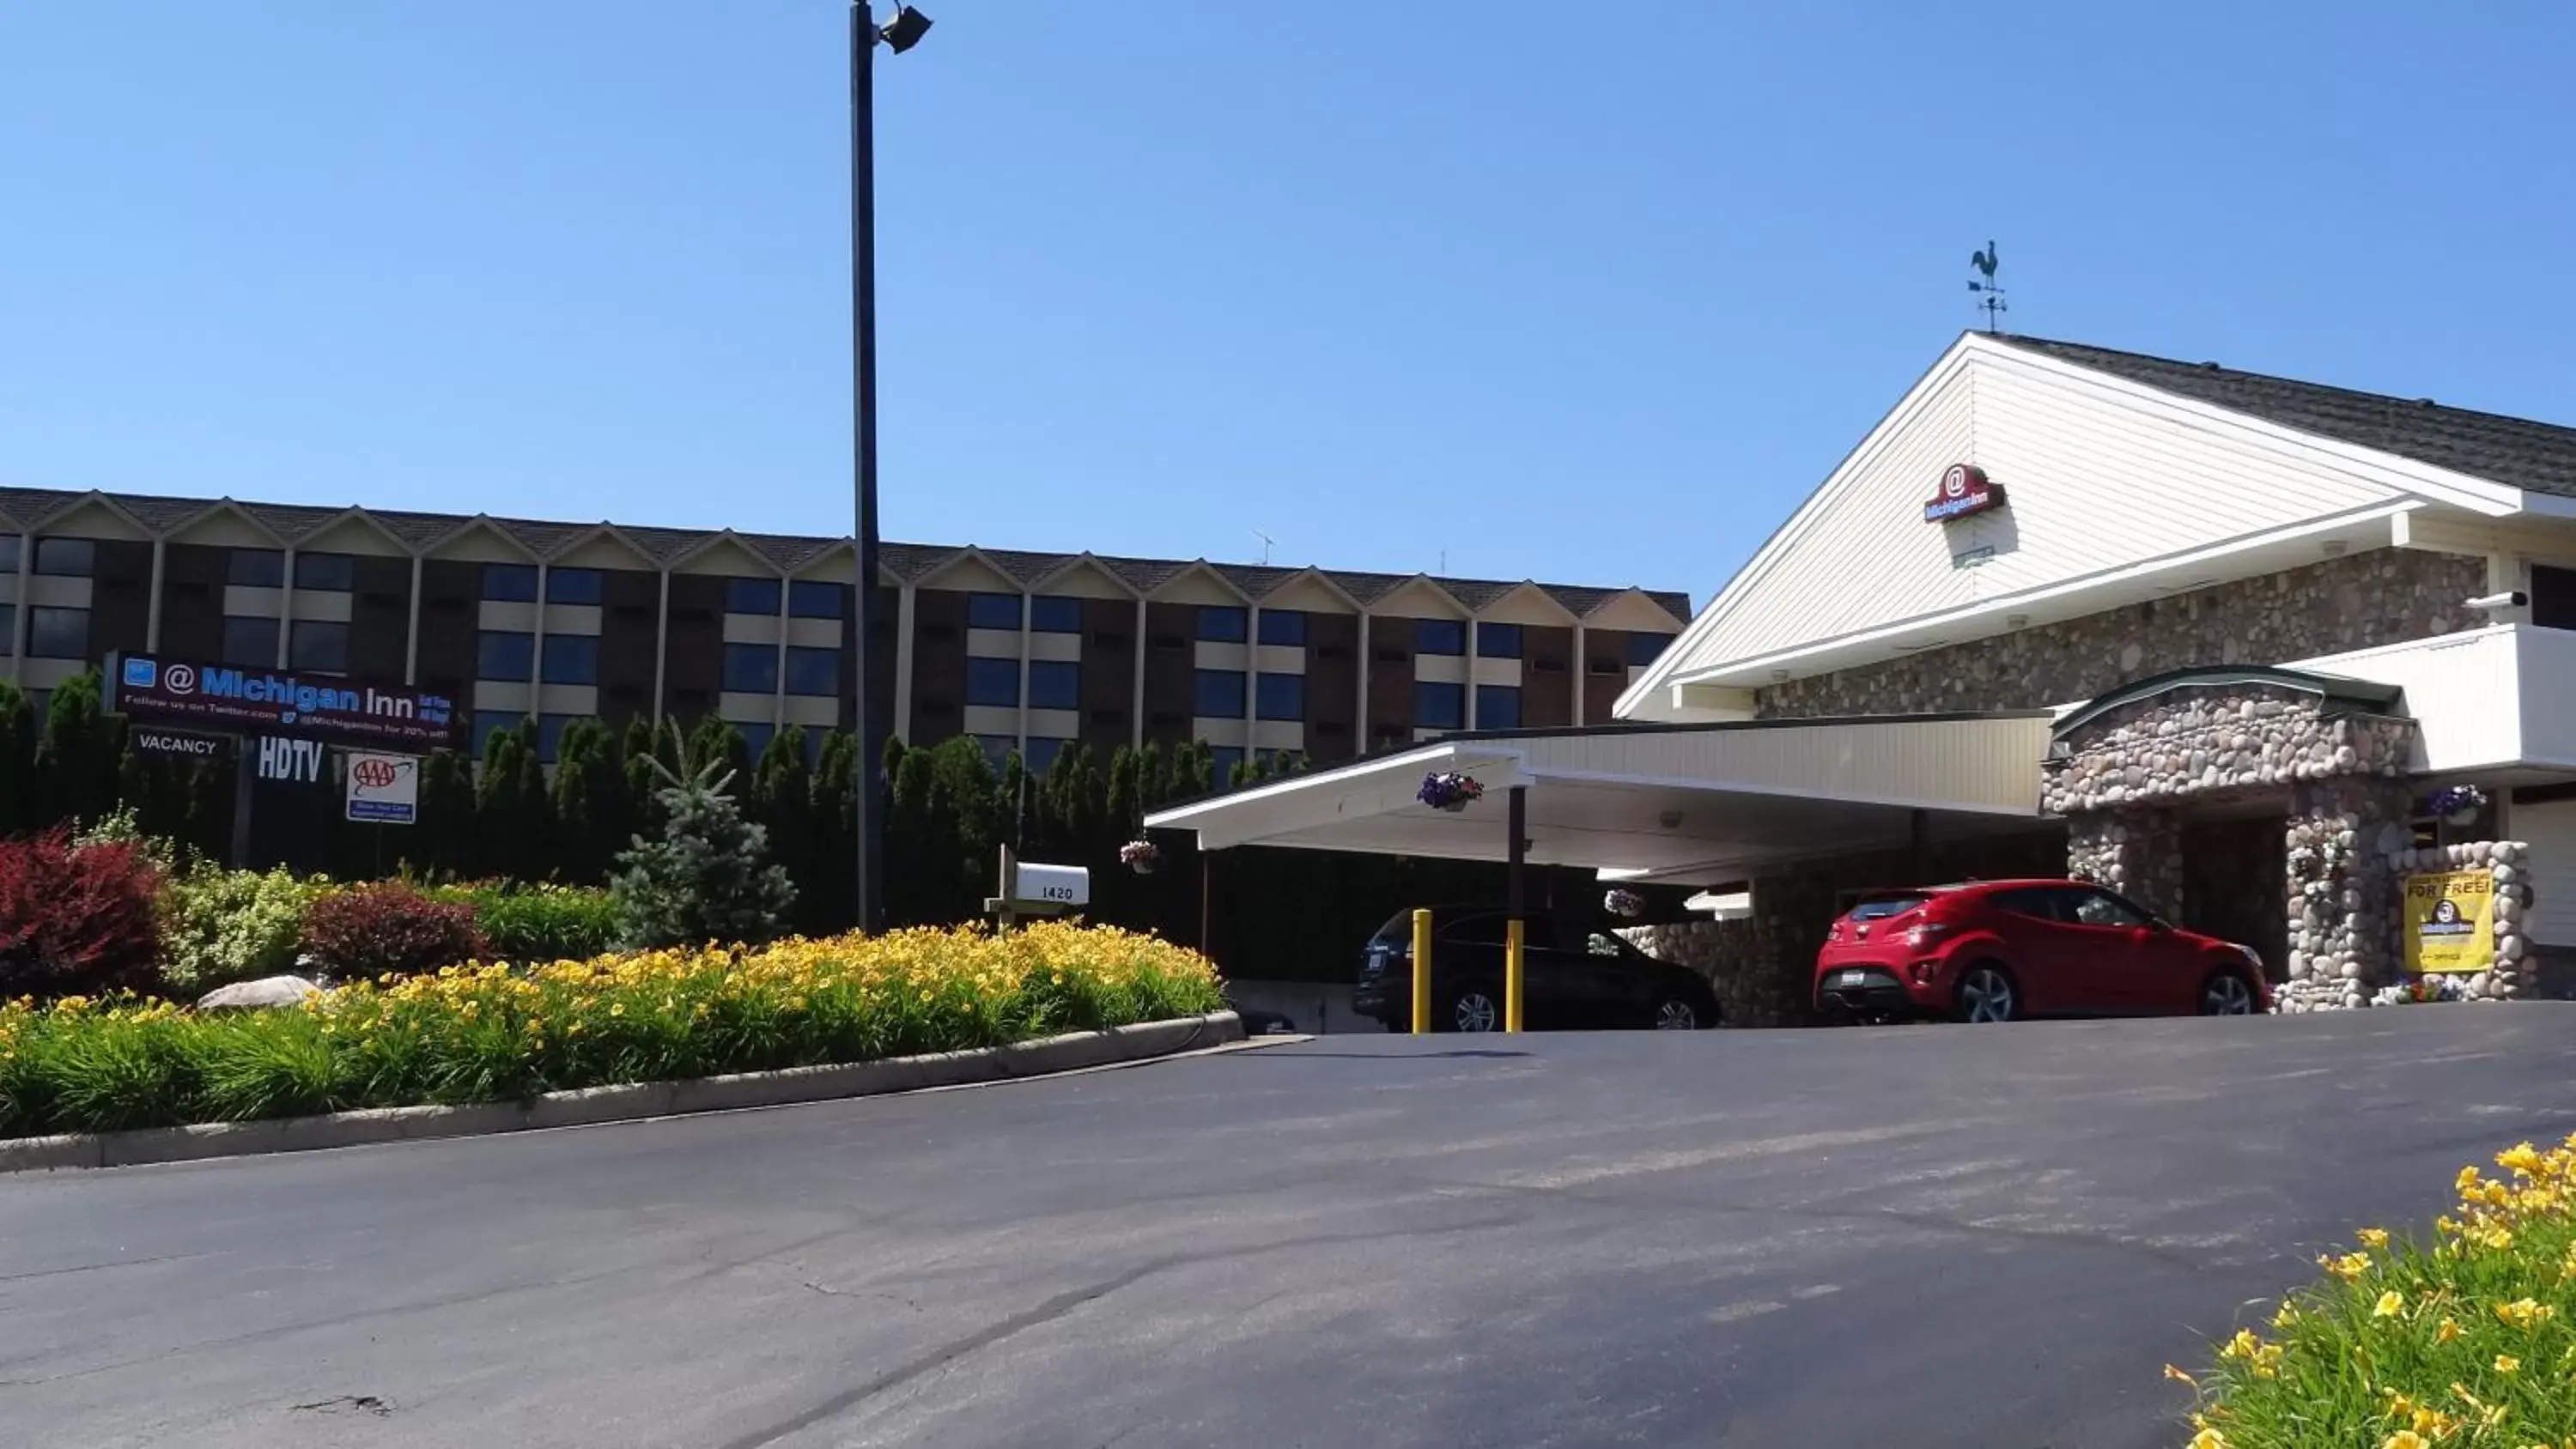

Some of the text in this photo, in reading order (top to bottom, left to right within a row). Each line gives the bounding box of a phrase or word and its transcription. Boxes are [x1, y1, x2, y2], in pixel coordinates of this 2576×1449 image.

[1946, 466, 1965, 497] @
[125, 694, 167, 707] Follow
[171, 701, 185, 710] us
[164, 664, 195, 695] @
[366, 688, 414, 718] Inn
[139, 734, 217, 755] VACANCY
[258, 736, 324, 783] HDTV
[355, 761, 394, 786] AAA
[1043, 887, 1072, 900] 1420
[2407, 881, 2489, 897] FOR FREE!
